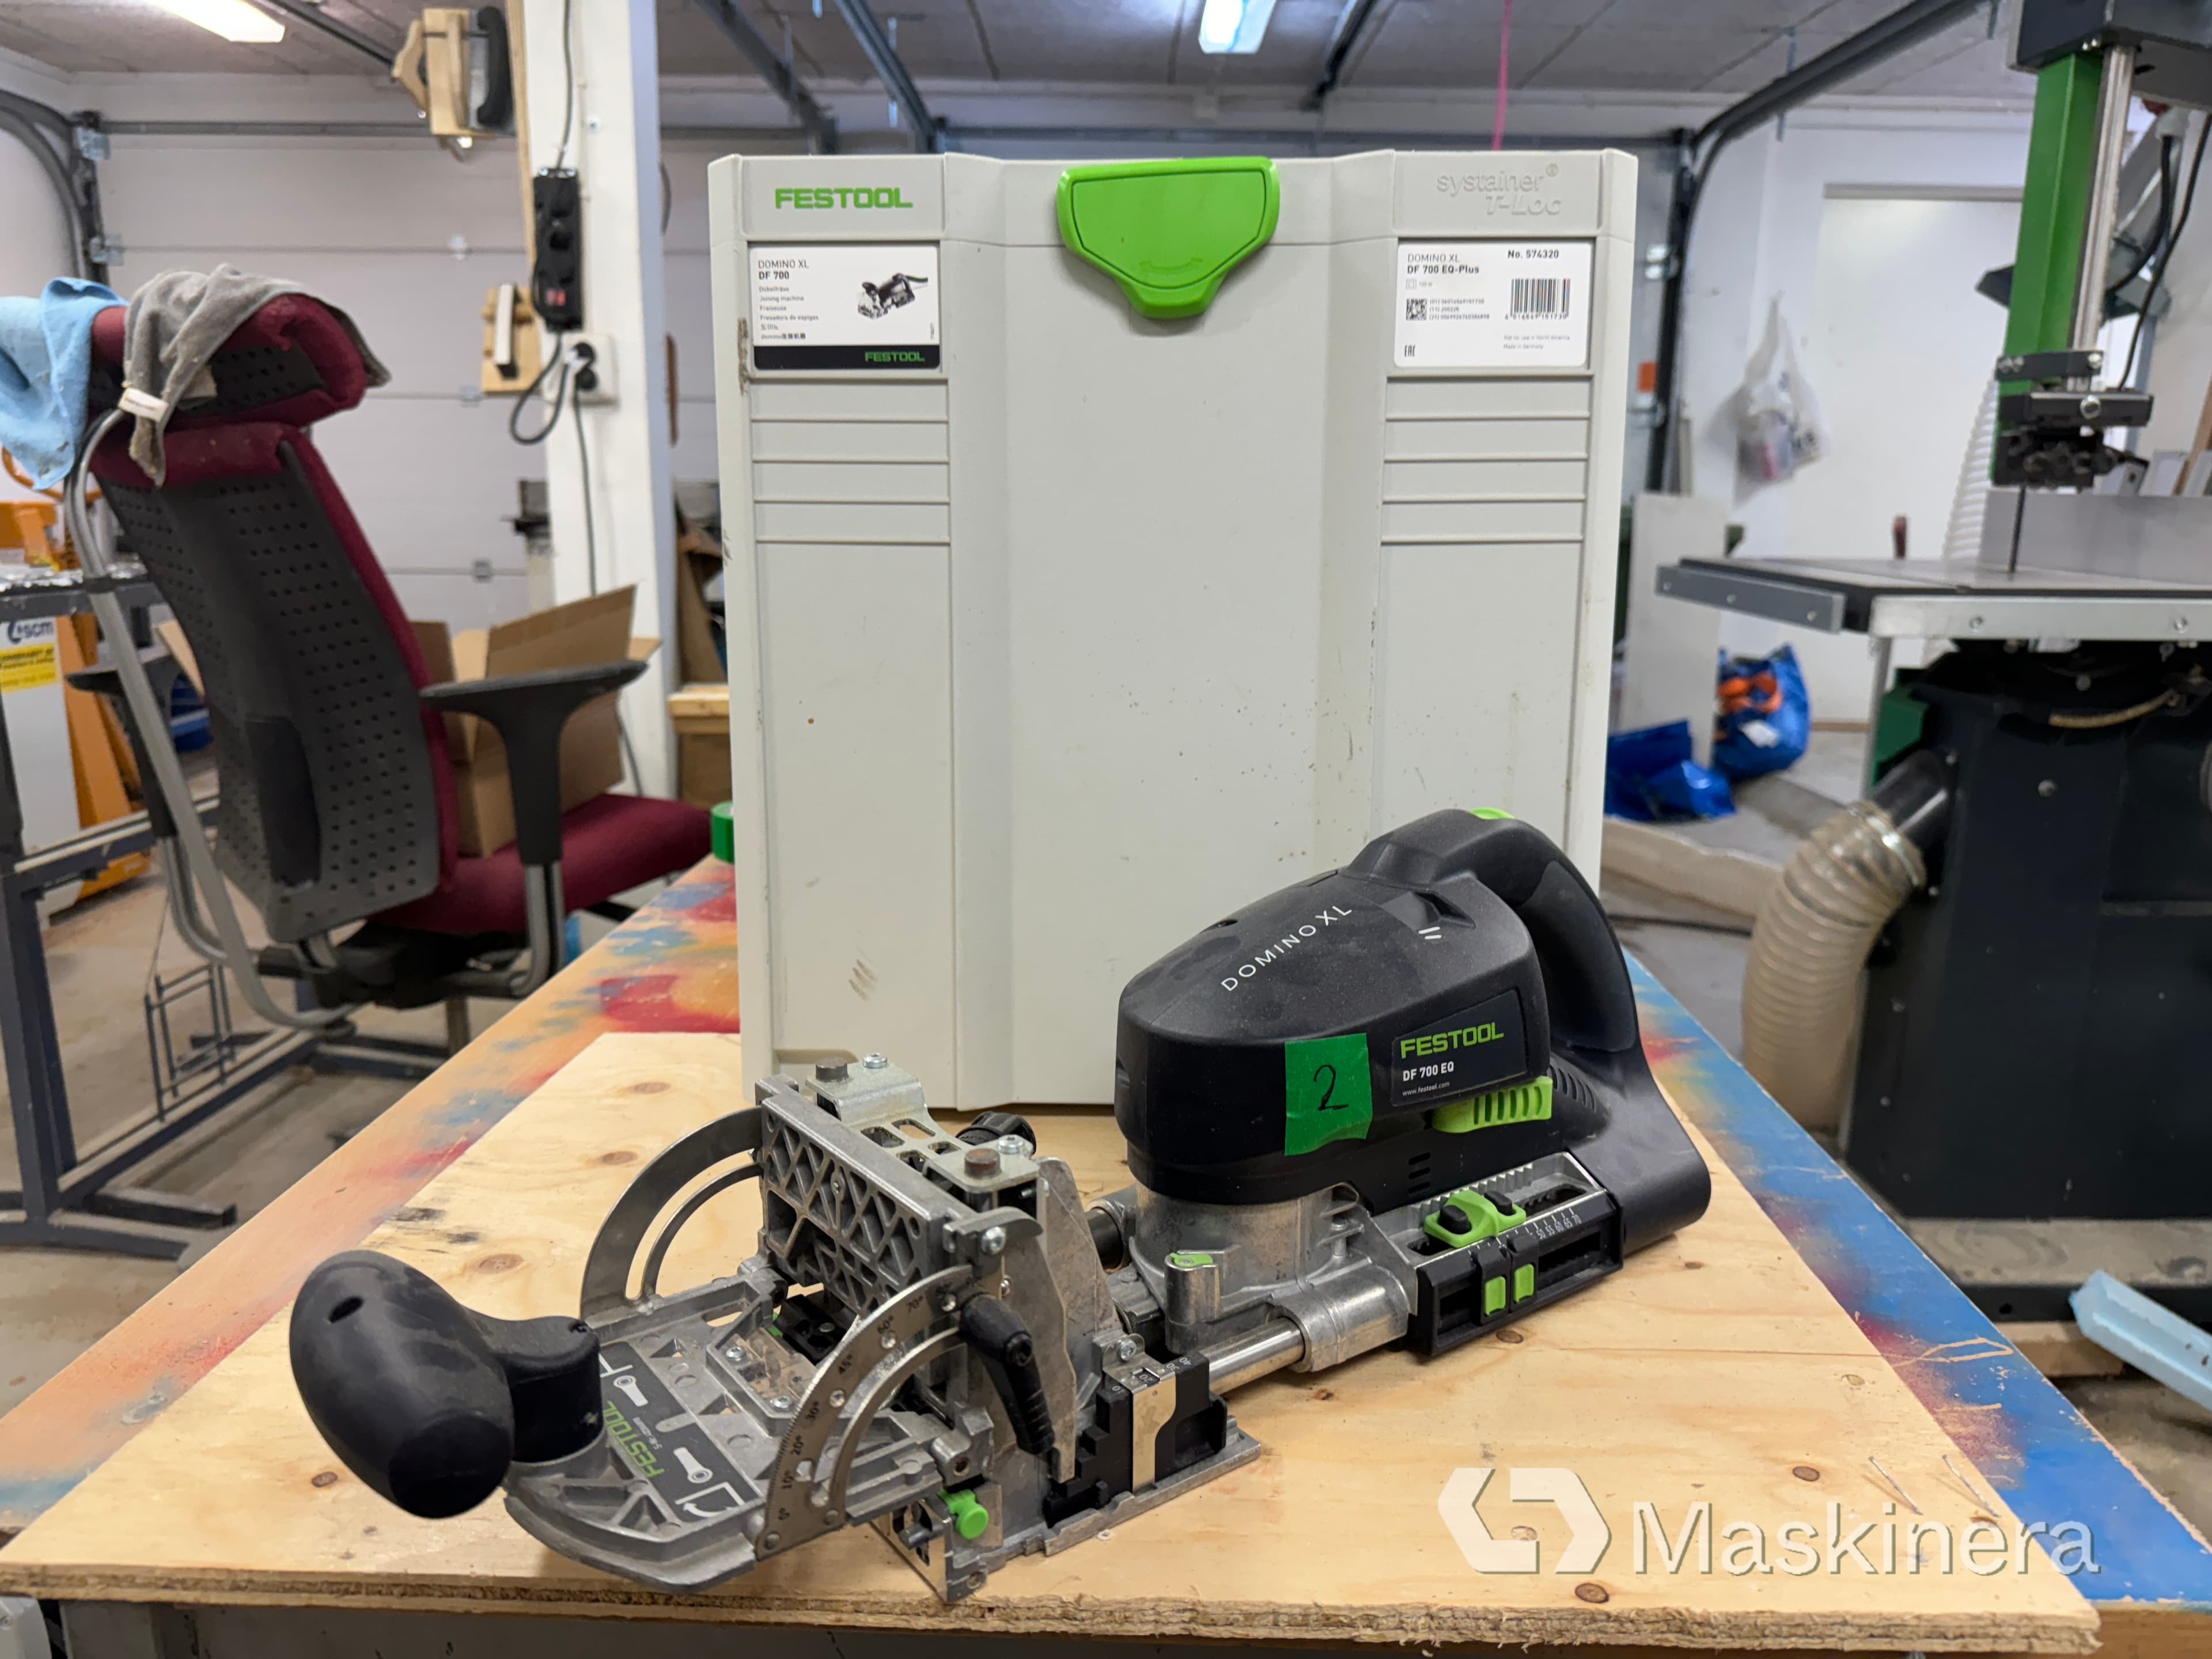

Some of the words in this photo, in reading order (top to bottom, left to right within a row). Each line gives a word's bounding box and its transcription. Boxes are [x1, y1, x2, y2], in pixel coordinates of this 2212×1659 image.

[775, 188, 914, 209] FESTOOL
[1408, 253, 1446, 263] DOMINO
[1449, 253, 1460, 263] XL
[1508, 250, 1522, 259] No.
[1526, 249, 1559, 259] 574320
[757, 259, 796, 269] DOMINO
[798, 259, 810, 269] XL
[1407, 265, 1419, 274] DF
[1423, 265, 1440, 274] 700
[1442, 264, 1480, 274] EQ-Plus
[759, 271, 771, 280] DF
[773, 270, 789, 280] 700
[865, 351, 926, 362] FESTOOL
[1221, 924, 1317, 991] DOMINO
[1315, 906, 1352, 926] XL
[1400, 1022, 1504, 1059] FESTOOL
[1403, 1069, 1417, 1082] DF
[1419, 1065, 1438, 1078] 700
[1441, 1061, 1455, 1074] EQ
[1313, 1064, 1349, 1111] 2
[1402, 1081, 1450, 1096] www.festool.com
[1536, 1229, 1546, 1239] 50
[1545, 1225, 1555, 1236] 55
[1554, 1221, 1565, 1232] 60
[1563, 1217, 1573, 1229] 65
[1571, 1214, 1582, 1225] 70
[1139, 1374, 1154, 1384] 20
[603, 1400, 665, 1478] FESTOOL
